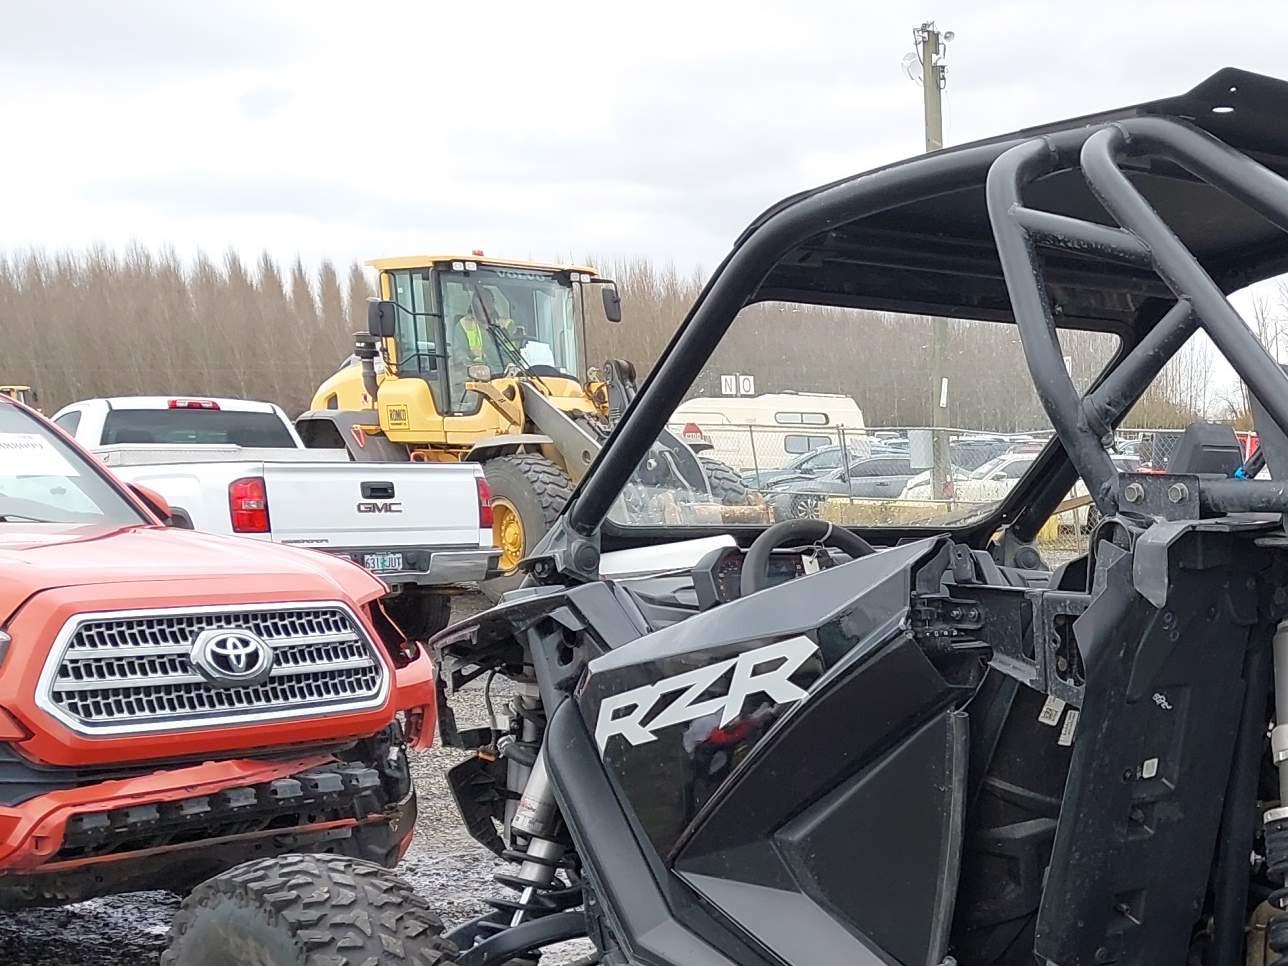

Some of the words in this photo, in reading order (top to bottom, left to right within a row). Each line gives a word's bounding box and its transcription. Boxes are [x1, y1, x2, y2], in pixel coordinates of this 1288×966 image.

[496, 270, 546, 281] VOLVO
[357, 502, 403, 513] GMC
[365, 557, 380, 569] 631
[595, 635, 819, 763] RZR
